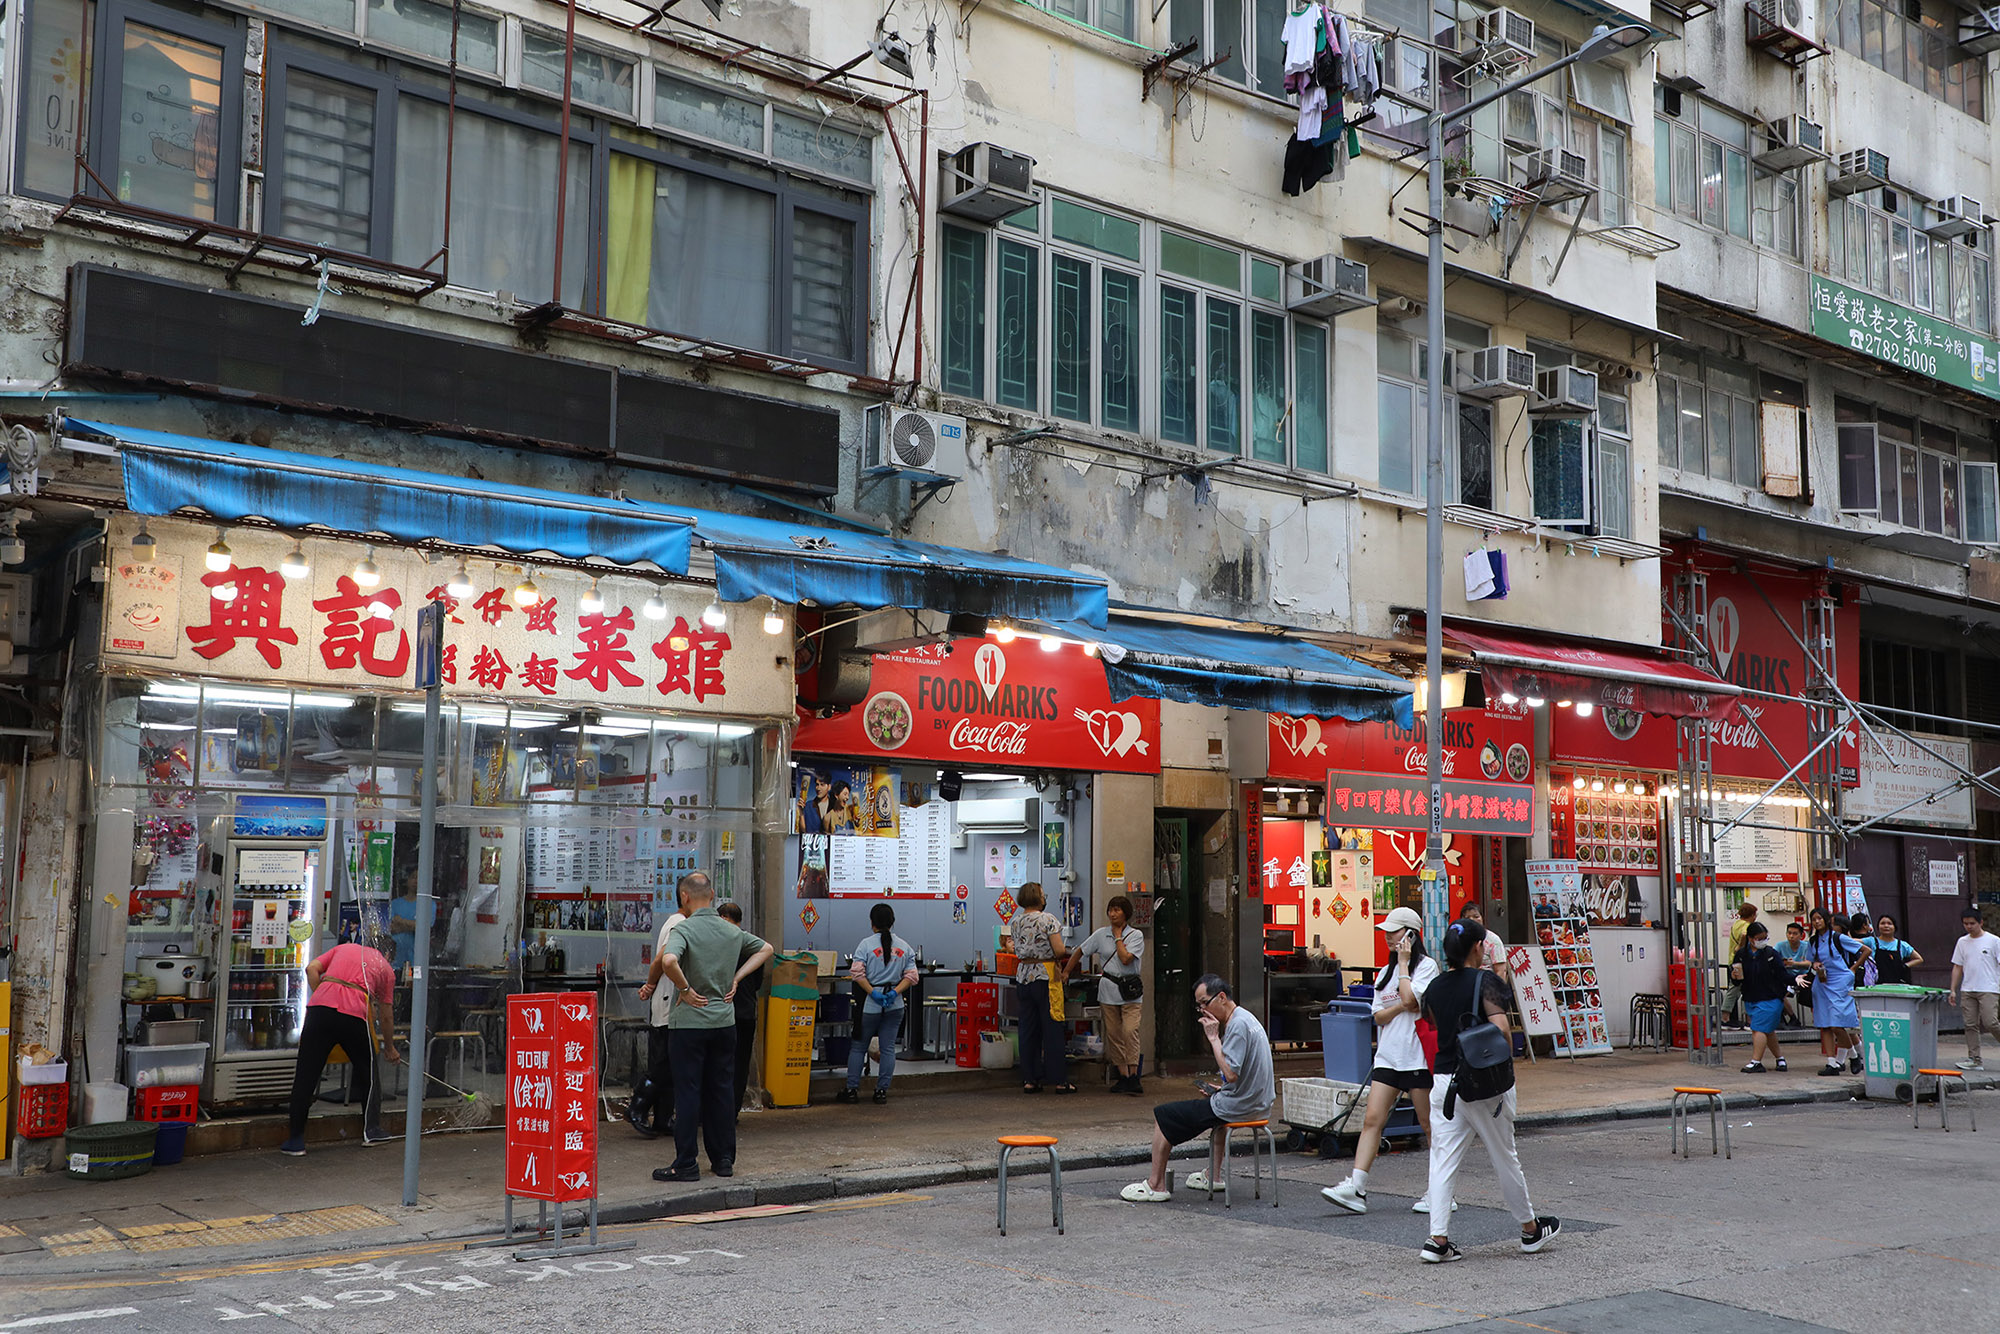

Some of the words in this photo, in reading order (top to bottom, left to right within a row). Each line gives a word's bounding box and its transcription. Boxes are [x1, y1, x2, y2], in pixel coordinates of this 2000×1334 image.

[1866, 334, 1900, 363] 2782
[1903, 347, 1937, 375] 5006
[564, 605, 732, 704] 菜館
[876, 653, 890, 661] HING
[904, 657, 941, 666] RESTAURANT
[918, 675, 1058, 721] FOODMARKS
[934, 718, 949, 731] BY
[949, 717, 1032, 755] Coca-Cola
[1394, 746, 1405, 755] BY
[1875, 762, 1887, 772] CHI
[1902, 764, 1932, 777] CUTLERY
[1534, 974, 1552, 1012] 牛丸
[516, 1050, 550, 1070] 可口可樂
[564, 1041, 584, 1150] 歡迎光臨
[505, 1248, 745, 1282] LOOK
[214, 1275, 493, 1321] RIGHT
